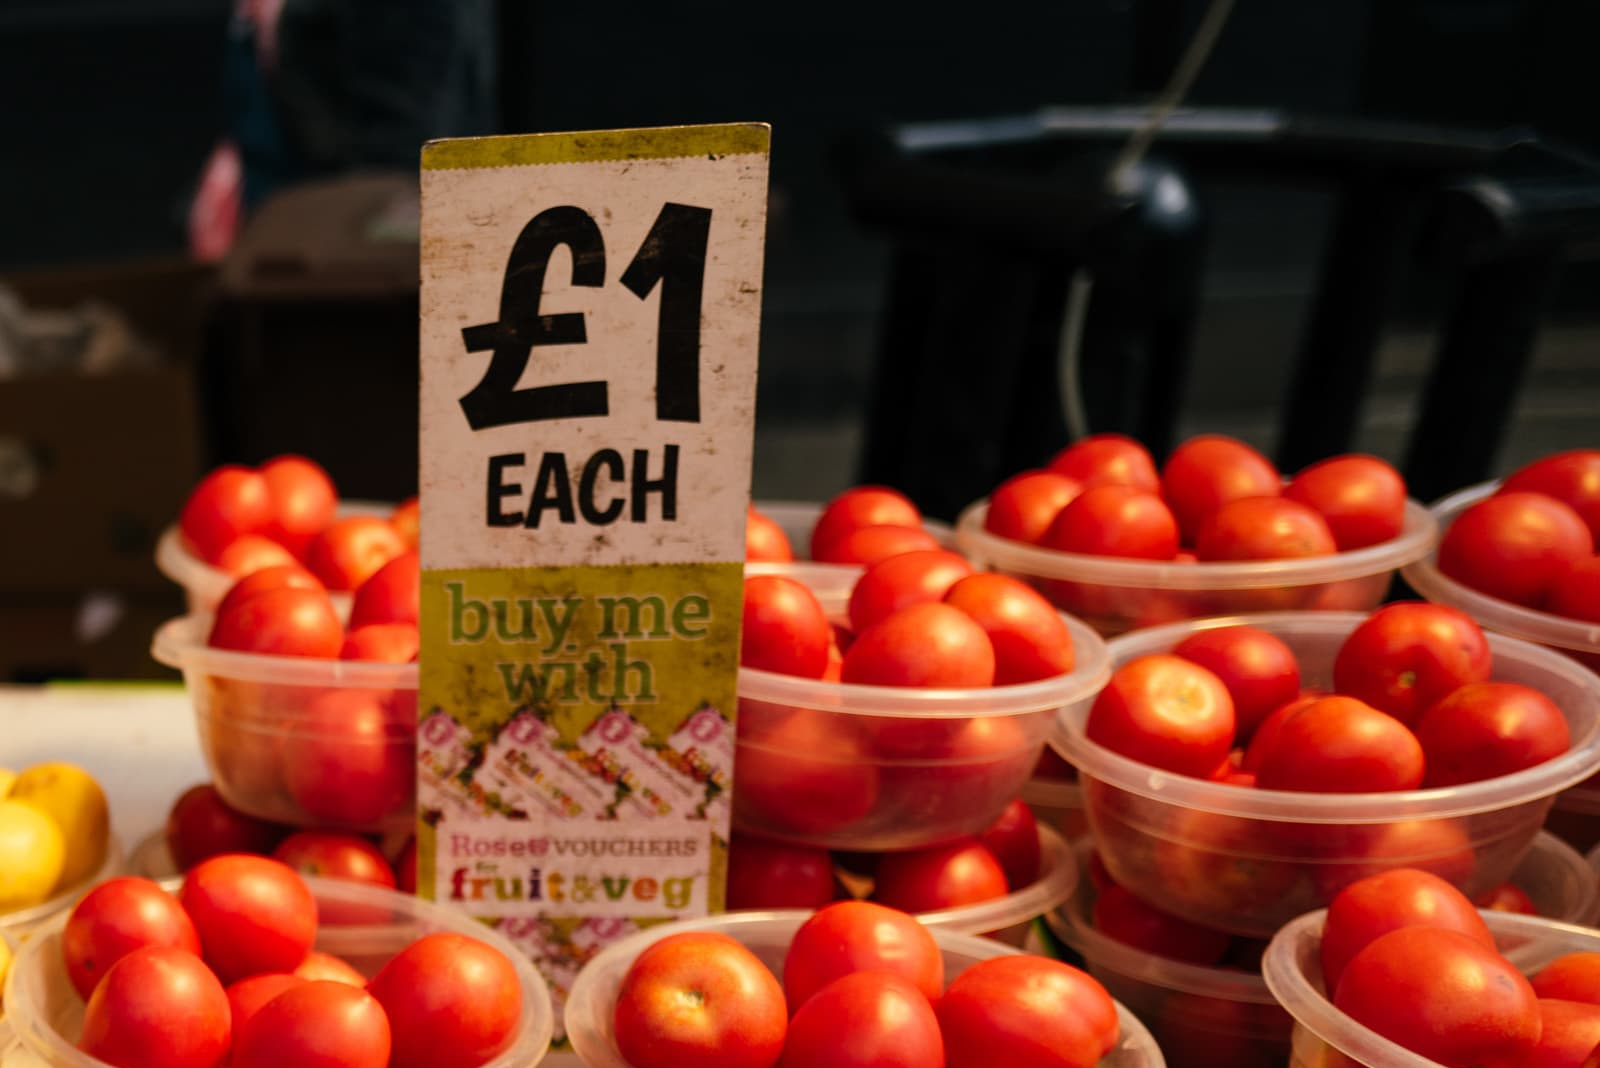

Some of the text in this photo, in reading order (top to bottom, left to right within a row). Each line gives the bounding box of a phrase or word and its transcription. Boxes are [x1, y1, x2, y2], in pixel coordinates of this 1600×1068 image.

[459, 202, 713, 431] £1
[486, 444, 680, 528] EACH
[445, 581, 712, 658] buy me
[496, 642, 657, 704] with
[552, 838, 698, 858] VOUCHERS
